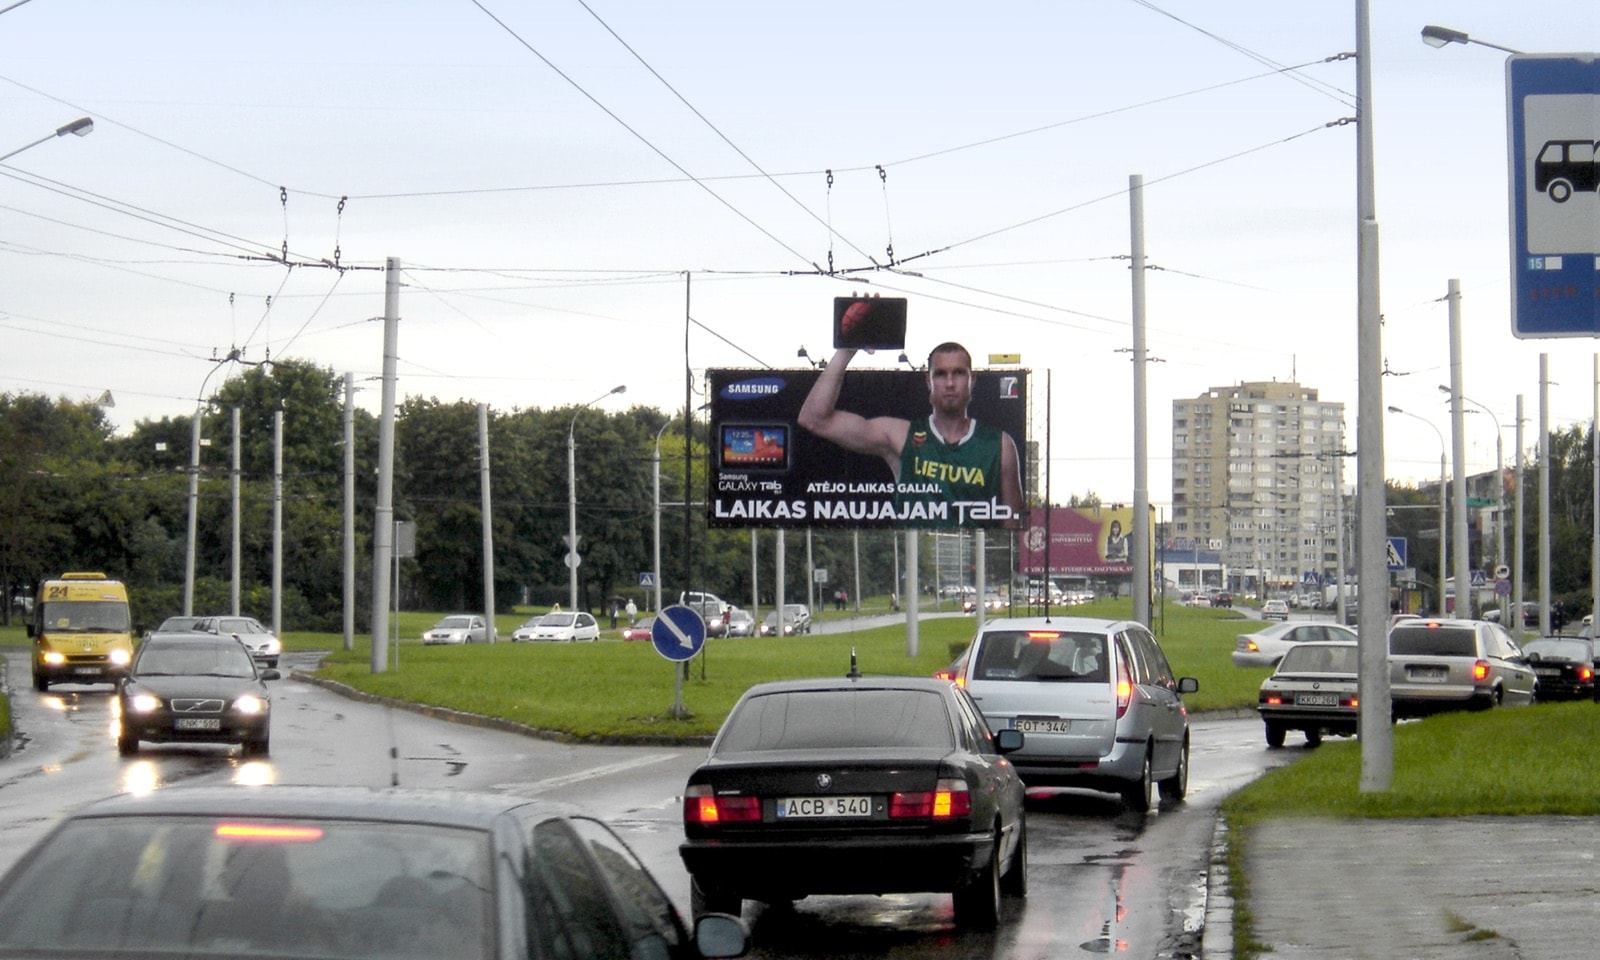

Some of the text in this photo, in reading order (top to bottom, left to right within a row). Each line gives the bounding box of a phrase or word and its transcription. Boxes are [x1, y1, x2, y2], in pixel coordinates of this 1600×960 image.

[1530, 257, 1543, 270] 15
[728, 384, 779, 394] SAMSUNG
[718, 472, 748, 482] Samsung
[914, 456, 985, 487] LIETUVA
[718, 480, 758, 491] GALAXY
[806, 480, 942, 493] ATĖJO LAIKAS GALIAI.
[715, 499, 807, 519] LAIKAS
[813, 500, 948, 520] NAUJAJAM
[1046, 722, 1067, 732] 344
[788, 799, 869, 815] ACB 540
